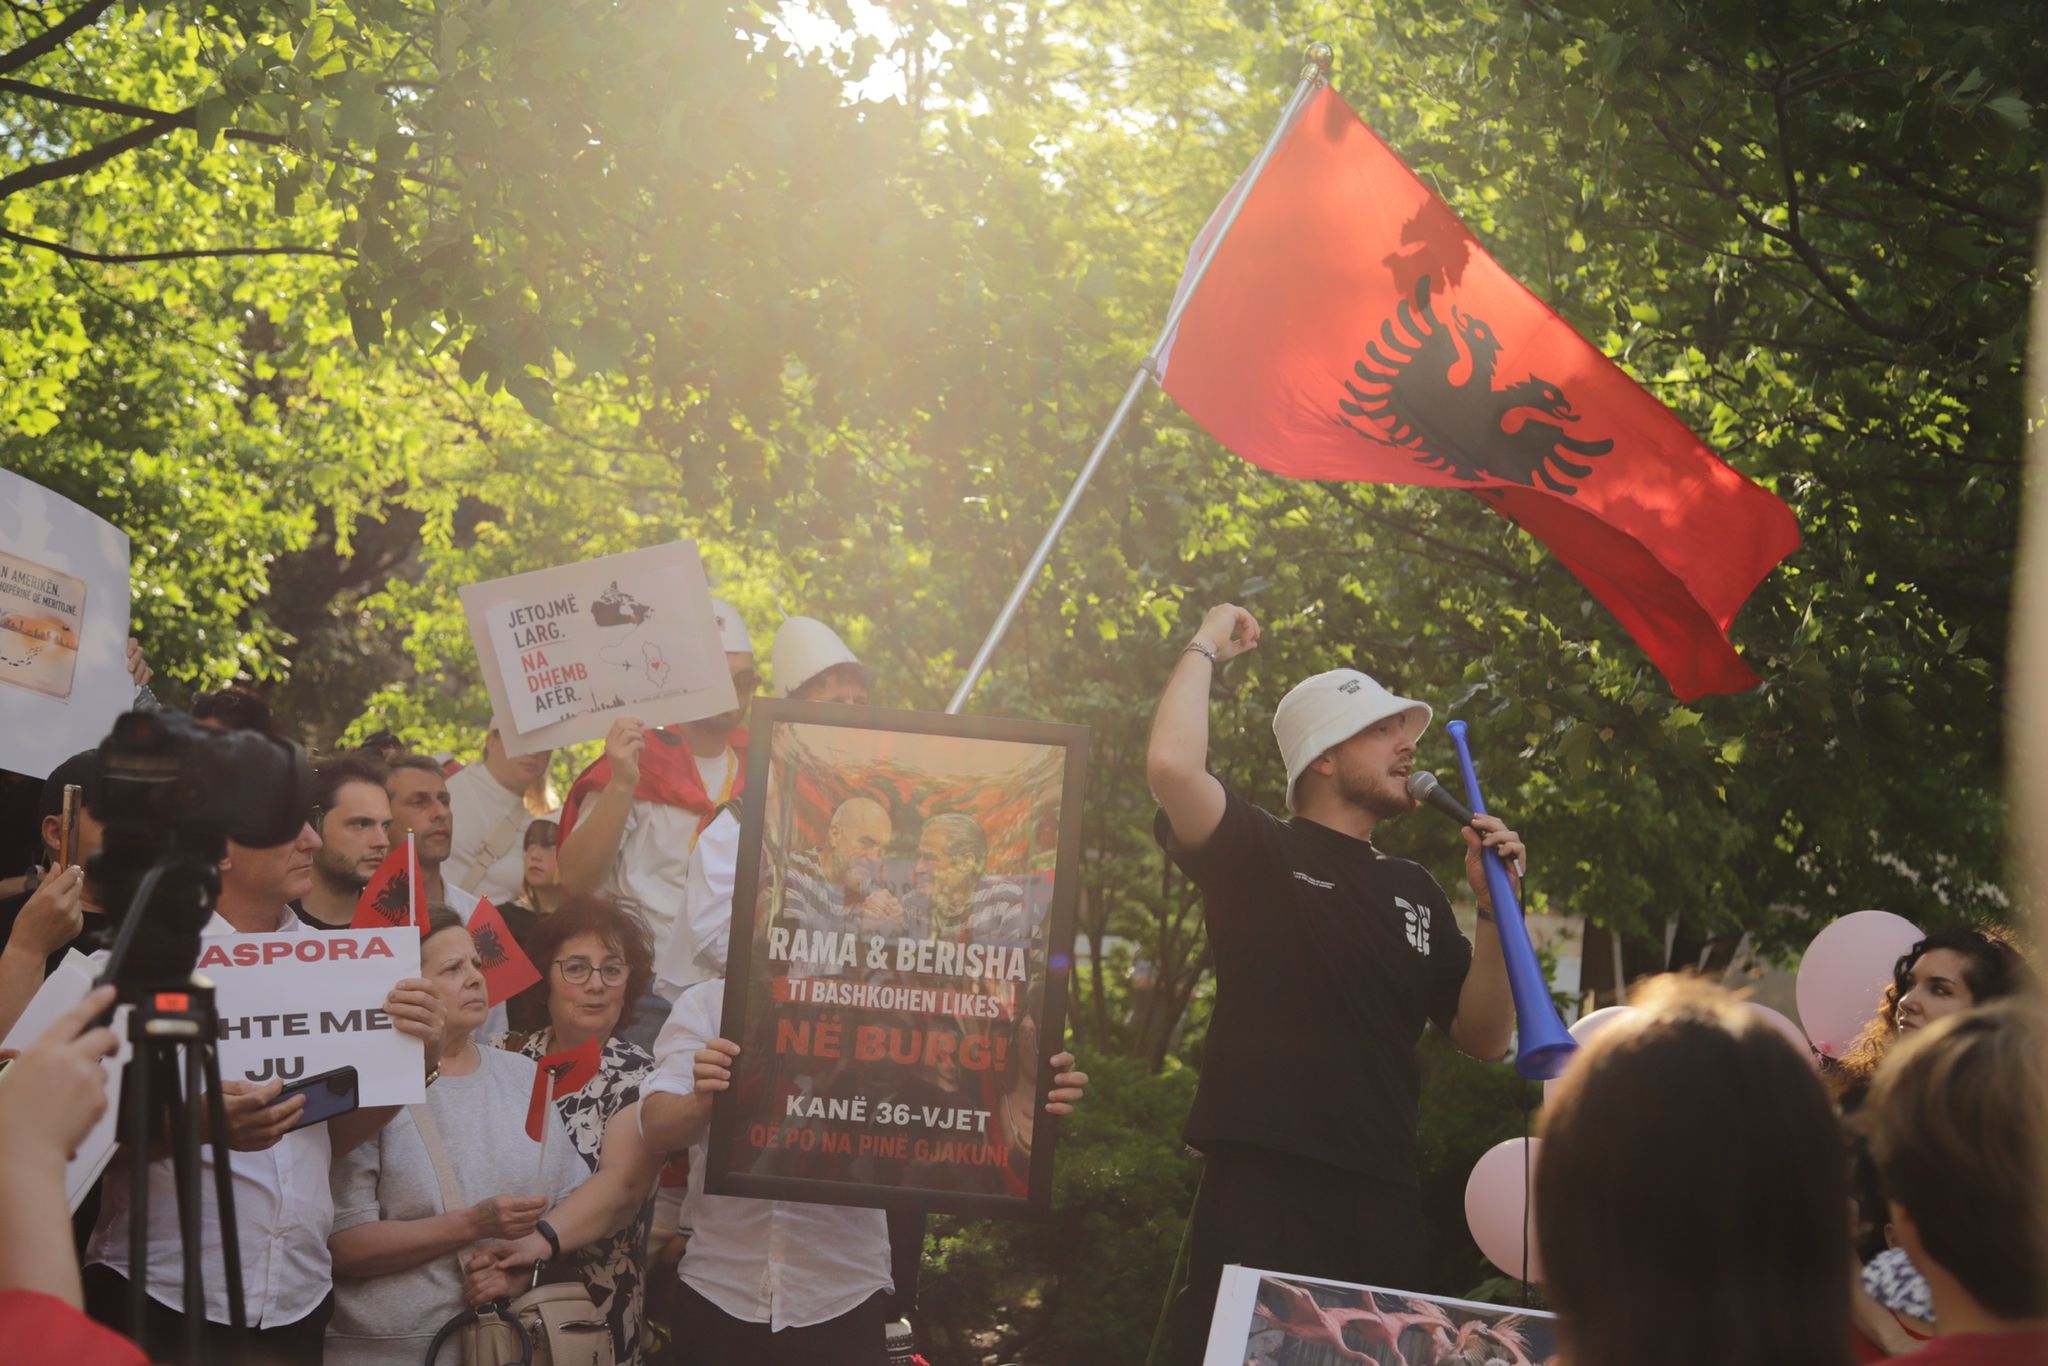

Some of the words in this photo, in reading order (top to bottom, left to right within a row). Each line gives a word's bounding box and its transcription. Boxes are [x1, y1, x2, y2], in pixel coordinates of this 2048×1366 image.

[508, 594, 579, 629] JETOJMË
[514, 622, 566, 649] LARG.
[521, 651, 549, 673] NA
[527, 662, 588, 693] DHEMB
[536, 686, 582, 713] AFËR.
[197, 936, 394, 969] ASPORA
[768, 927, 857, 968] RAMA
[866, 935, 889, 971] &
[896, 938, 1027, 983] BERISHA
[788, 979, 806, 1001] TI
[811, 981, 936, 1014] BASHKOHEN
[219, 1013, 310, 1040] HTE
[320, 1008, 393, 1033] ME
[775, 1013, 843, 1058] NË
[855, 1025, 1009, 1072] BURG!
[244, 1056, 305, 1082] JU
[786, 1095, 867, 1122] KANË
[876, 1103, 991, 1133] 36-VJET
[750, 1123, 779, 1149] QË
[784, 1127, 817, 1151] PO
[822, 1132, 851, 1155] NA
[858, 1133, 908, 1160] PINË
